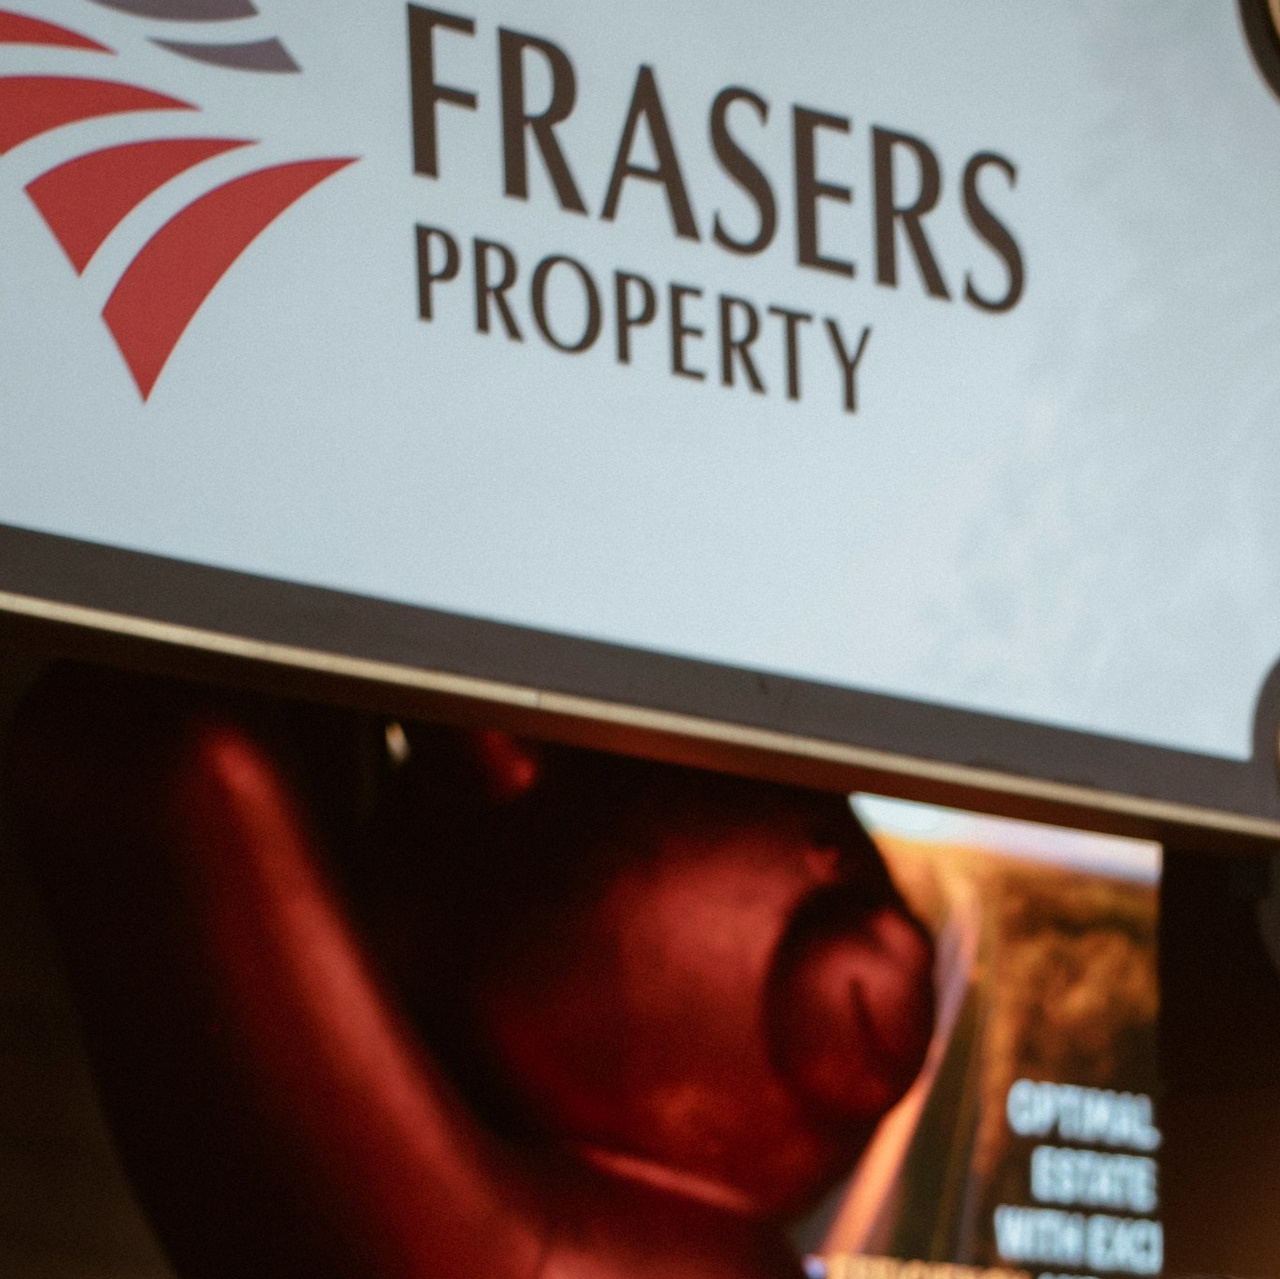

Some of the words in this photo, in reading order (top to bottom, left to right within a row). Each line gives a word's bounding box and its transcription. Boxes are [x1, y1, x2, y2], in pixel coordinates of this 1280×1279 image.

[406, 4, 1026, 316] FRASERS
[413, 221, 872, 415] PROPERTY
[993, 1203, 1086, 1268] WITH
